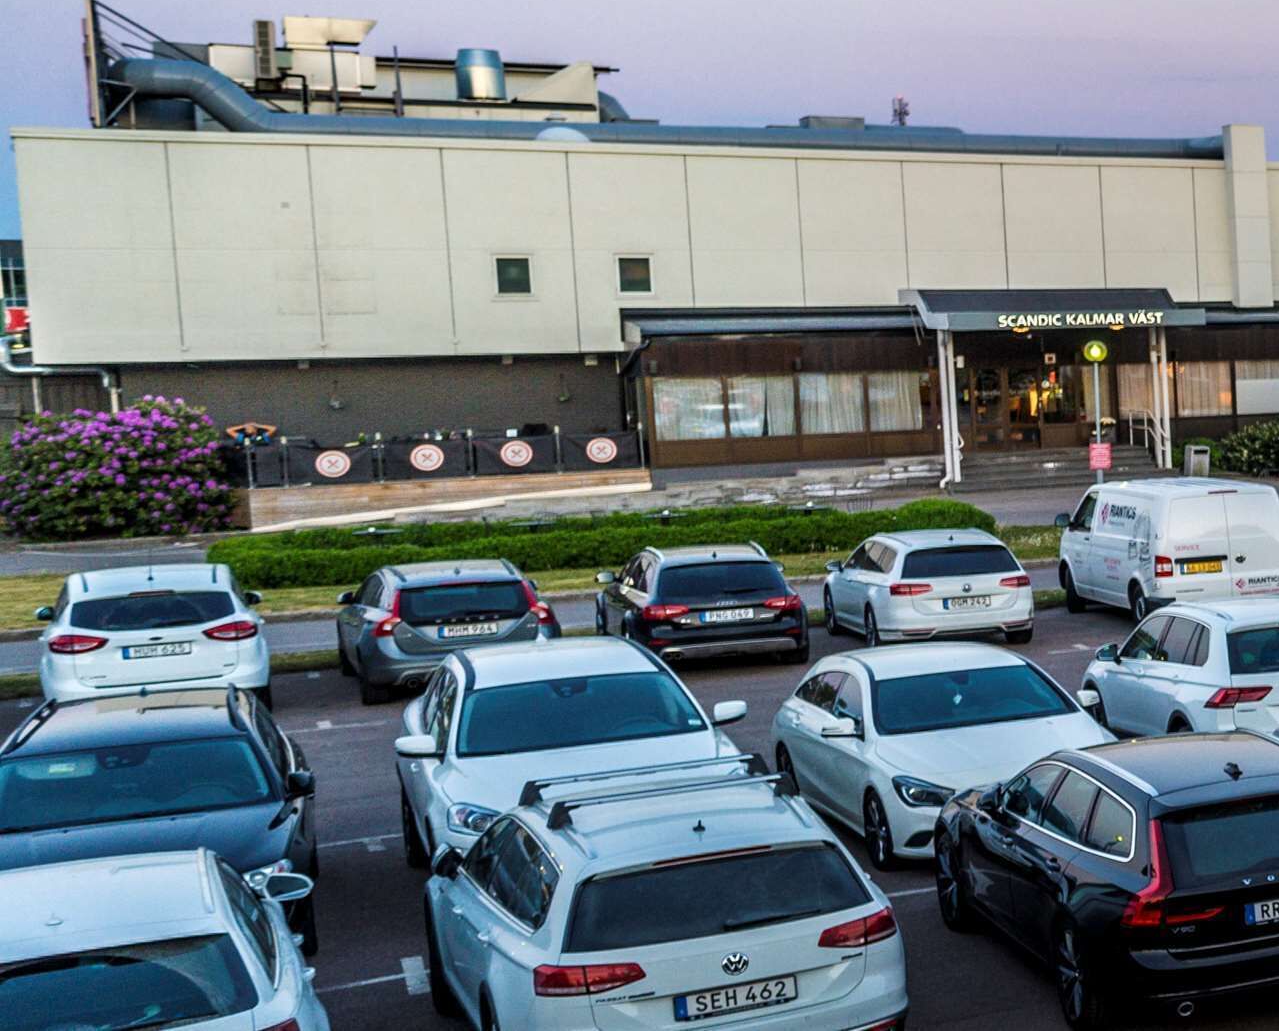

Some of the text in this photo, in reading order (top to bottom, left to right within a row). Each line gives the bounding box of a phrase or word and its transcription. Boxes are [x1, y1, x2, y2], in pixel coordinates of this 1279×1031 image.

[998, 309, 1163, 327] SCANDIC KALMAR VÄST
[1110, 504, 1136, 520] RIANTICS
[161, 643, 185, 654] 625
[696, 981, 787, 1012] SEH 462
